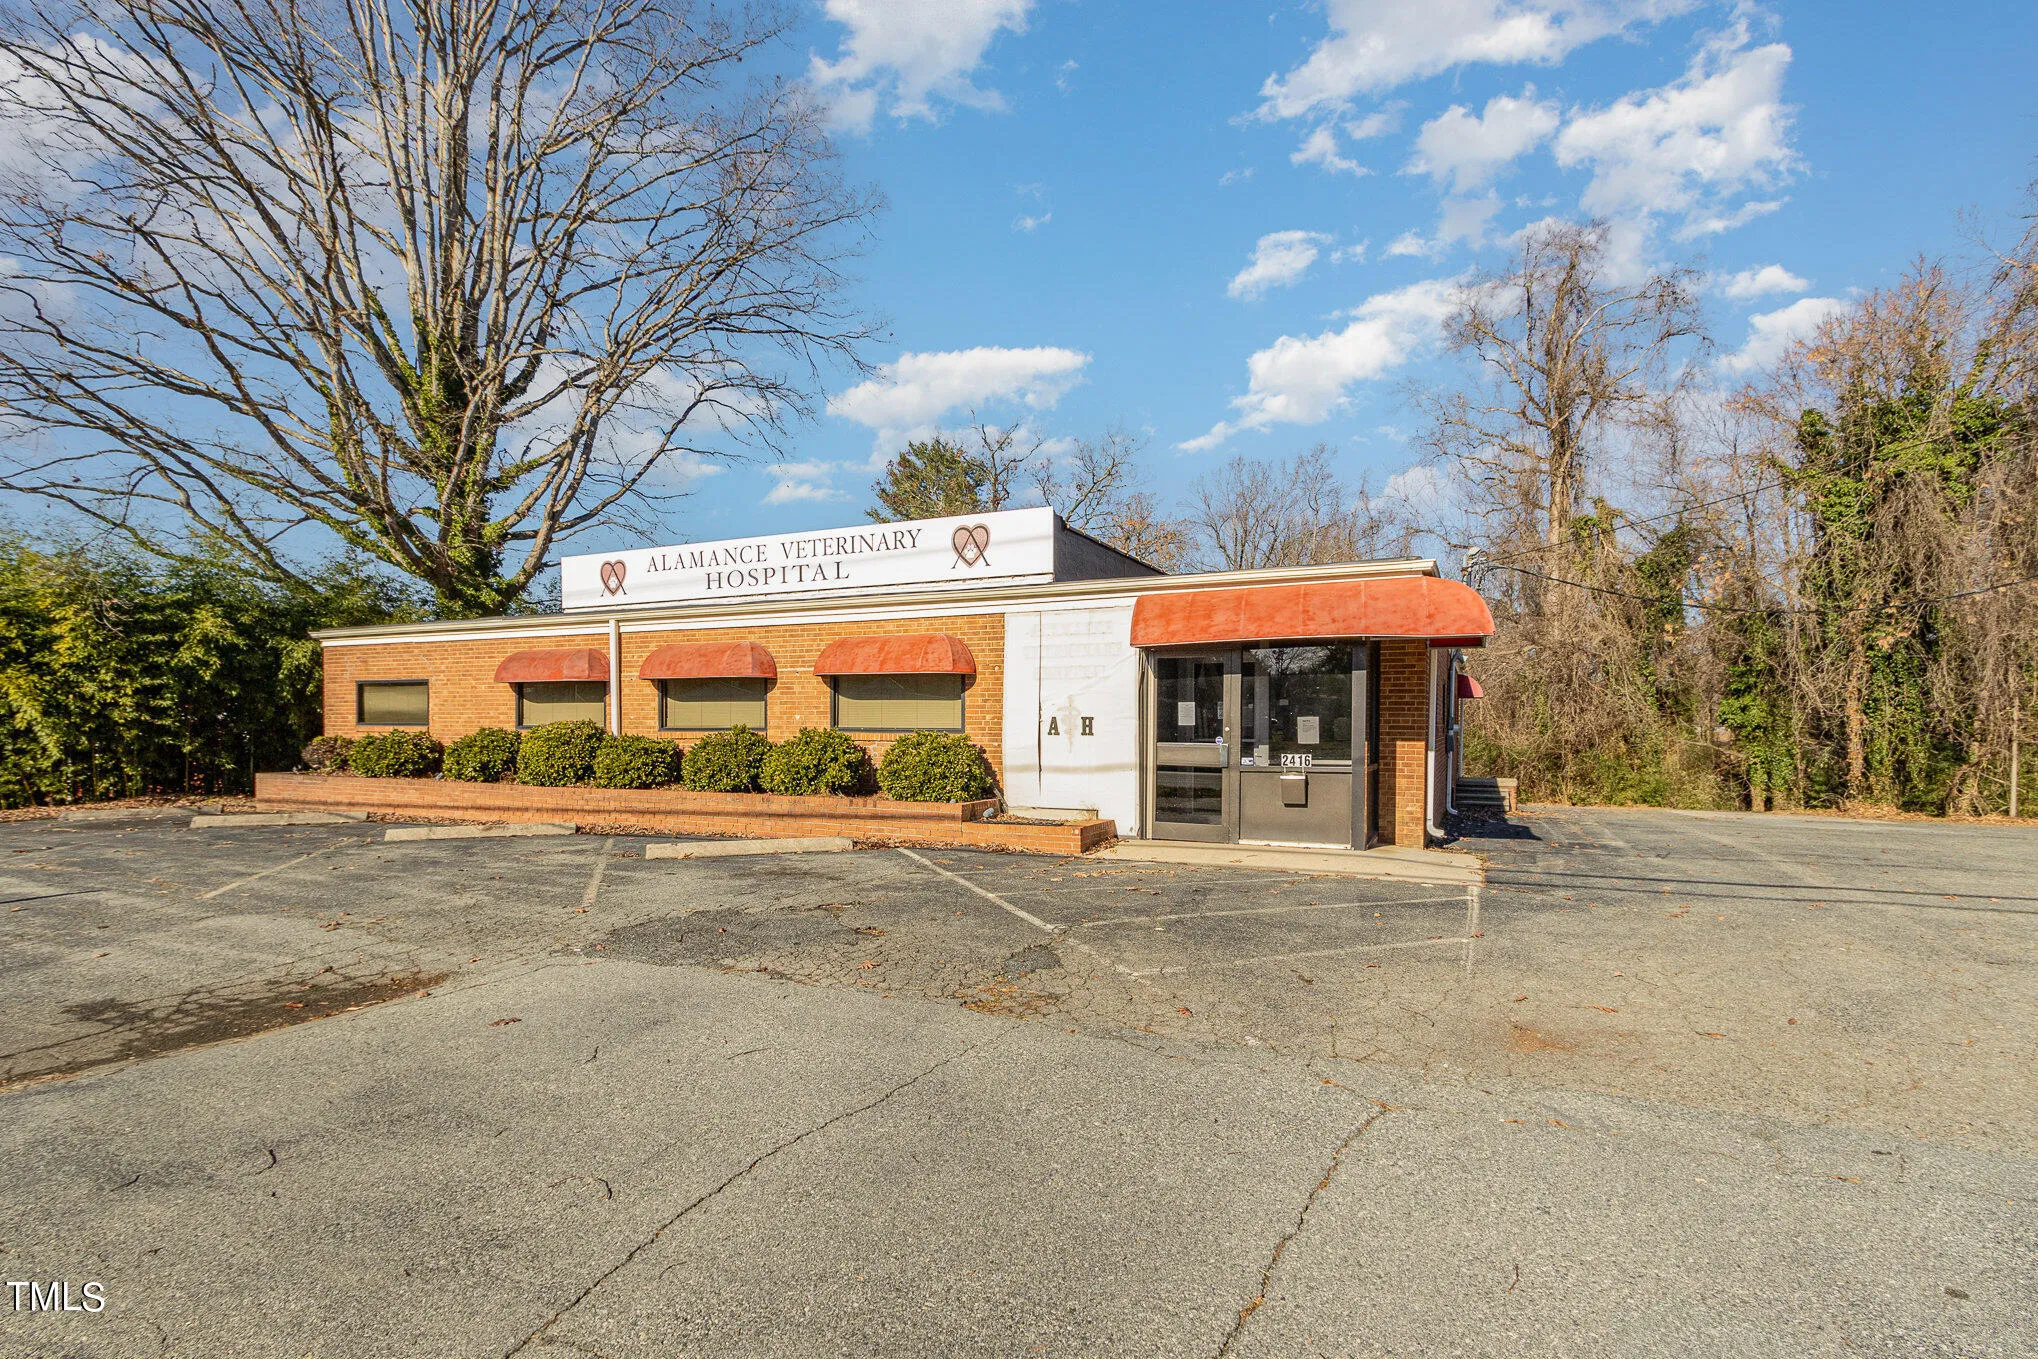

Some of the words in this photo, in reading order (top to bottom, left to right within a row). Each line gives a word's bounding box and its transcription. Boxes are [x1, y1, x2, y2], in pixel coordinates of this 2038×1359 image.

[647, 544, 768, 573] ALAMANCE
[780, 528, 922, 560] VETERINARY
[705, 561, 850, 590] HOSPITAL
[1047, 716, 1060, 736] A
[1080, 716, 1094, 736] H
[1282, 754, 1311, 767] 2416
